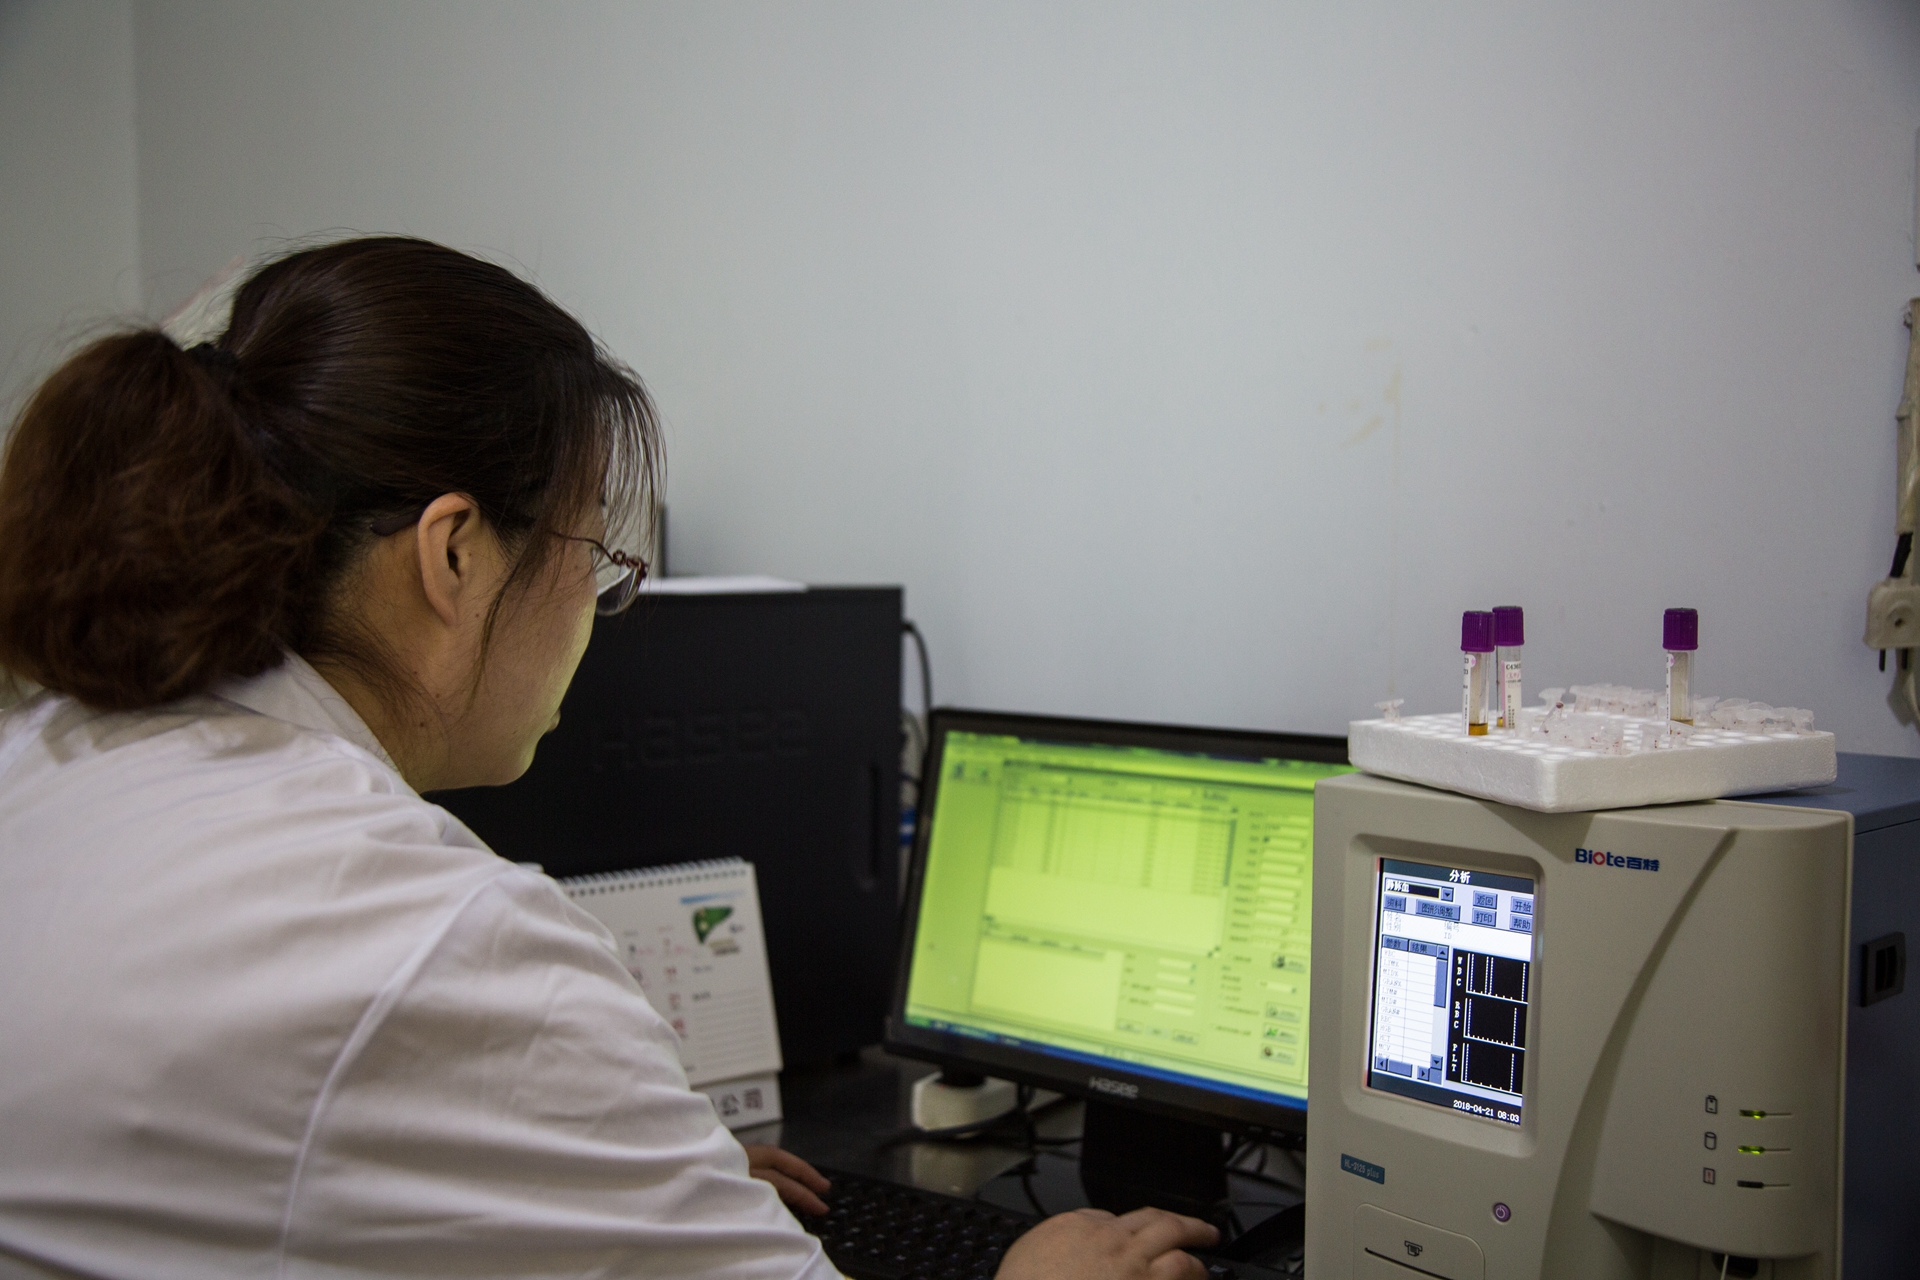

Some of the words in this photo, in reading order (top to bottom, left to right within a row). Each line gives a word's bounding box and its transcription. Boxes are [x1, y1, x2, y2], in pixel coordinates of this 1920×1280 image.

[1575, 848, 1626, 868] Biote
[1449, 869, 1471, 884] 分析
[1477, 895, 1494, 907] 返回
[1514, 900, 1532, 912] 开始
[1476, 913, 1493, 923] 打印
[1513, 919, 1531, 930] 帮助
[1444, 932, 1452, 940] ID
[1451, 1043, 1459, 1072] PLT
[1453, 1099, 1494, 1117] 2018-04-21
[1497, 1110, 1520, 1123] 08:03
